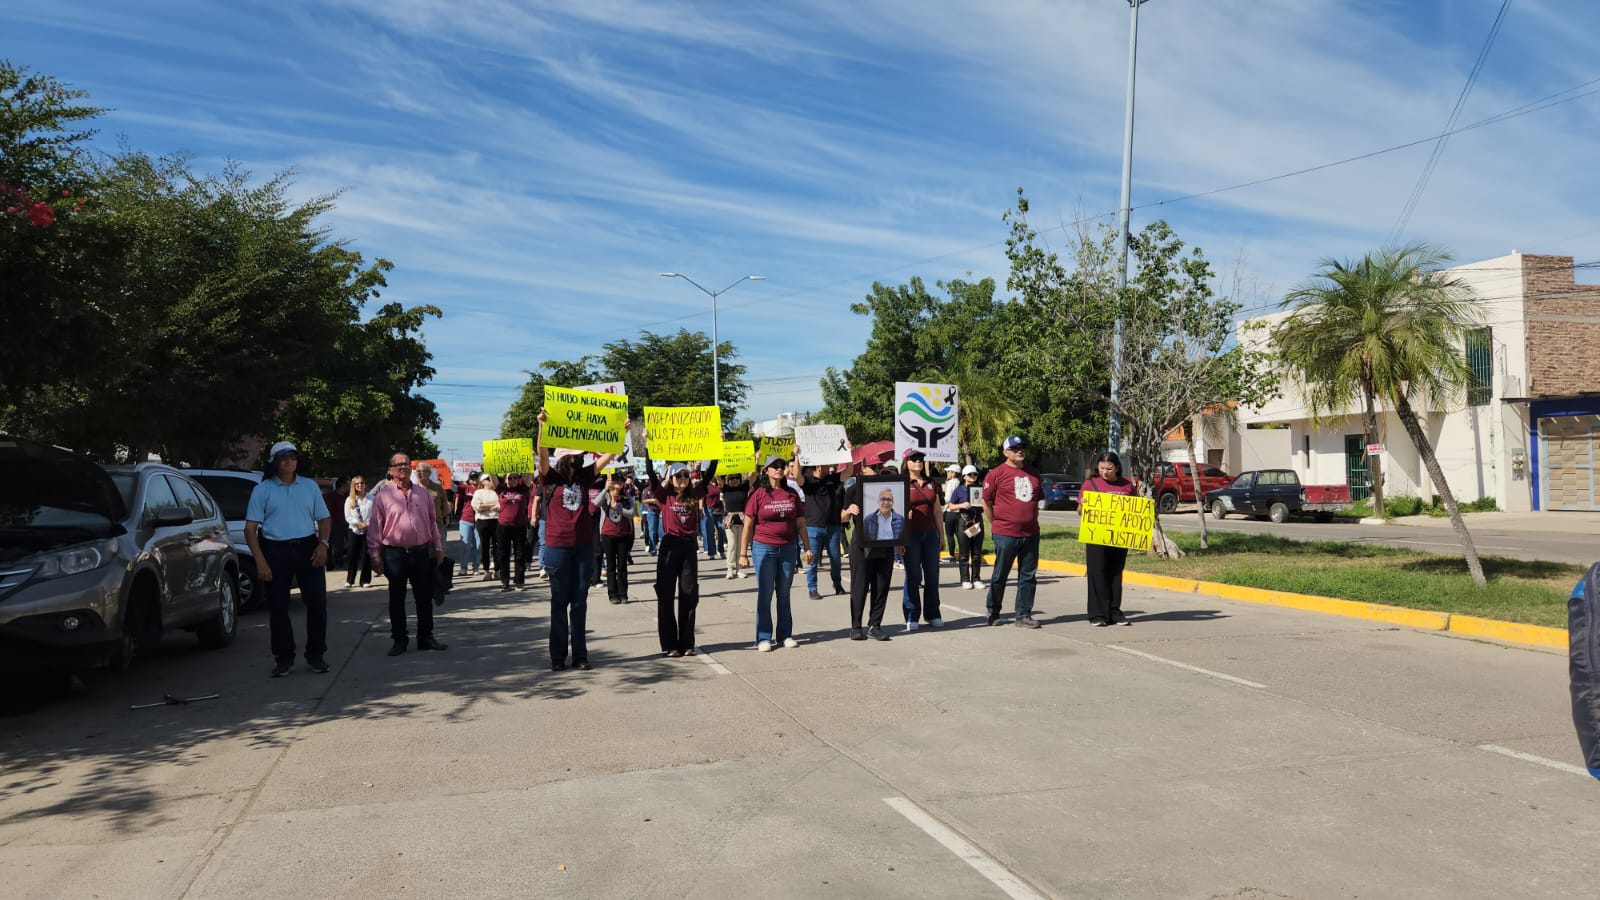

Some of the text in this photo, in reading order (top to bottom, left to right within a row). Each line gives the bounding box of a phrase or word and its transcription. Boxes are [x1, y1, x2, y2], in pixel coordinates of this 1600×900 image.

[546, 390, 555, 401] SI
[557, 392, 578, 404] HUBO
[566, 410, 607, 426] QUE HAYA
[548, 425, 619, 443] INDEMNIZACIÓN
[648, 427, 710, 441] JUSTA PARA
[652, 442, 703, 456] LA FAMILIA
[1087, 492, 1151, 515] LA FAMILIA
[1083, 510, 1152, 532] MERECE APOYO
[1087, 527, 1149, 550] Y JUSTICIA
